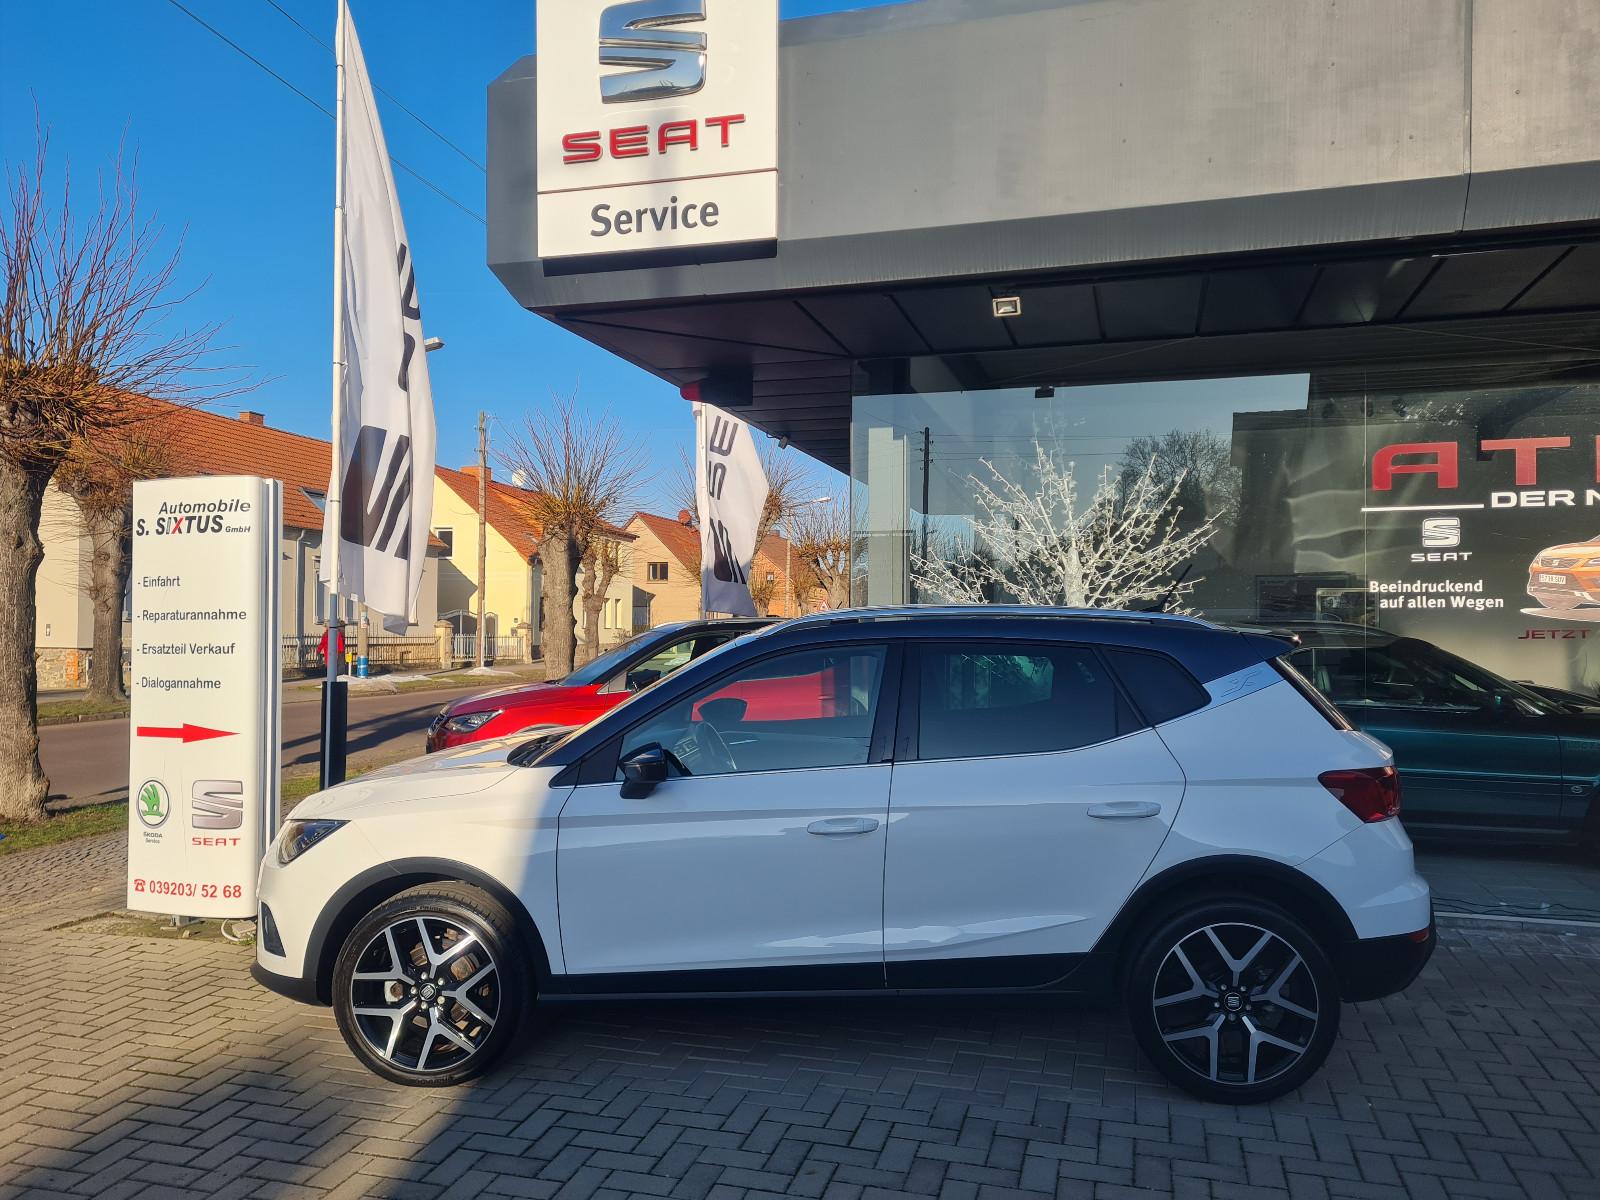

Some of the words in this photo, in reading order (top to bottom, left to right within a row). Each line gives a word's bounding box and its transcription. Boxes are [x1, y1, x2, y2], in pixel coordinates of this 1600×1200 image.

[561, 113, 745, 164] SEAT
[590, 196, 719, 237] Service
[1371, 434, 1600, 491] AT
[1491, 489, 1576, 508] DER
[159, 499, 251, 515] Automobile
[136, 518, 150, 536] S.
[225, 525, 251, 533] GmbH
[1410, 551, 1473, 562] SEAT
[143, 576, 181, 588] Einfahrt
[1369, 579, 1483, 593] Beeindruckend
[1379, 596, 1404, 609] auf
[1407, 596, 1447, 609] allen
[1450, 596, 1504, 610] Wegen
[142, 609, 247, 622] Reparaturannahme
[1518, 629, 1592, 640] JETZT
[141, 643, 187, 655] Ersatzteil
[189, 642, 236, 655] Verkauf
[141, 677, 221, 691] Dialogannahme
[191, 837, 241, 846] SEAT
[149, 880, 197, 897] 039203/
[201, 884, 218, 898] 52
[222, 884, 242, 898] 68
